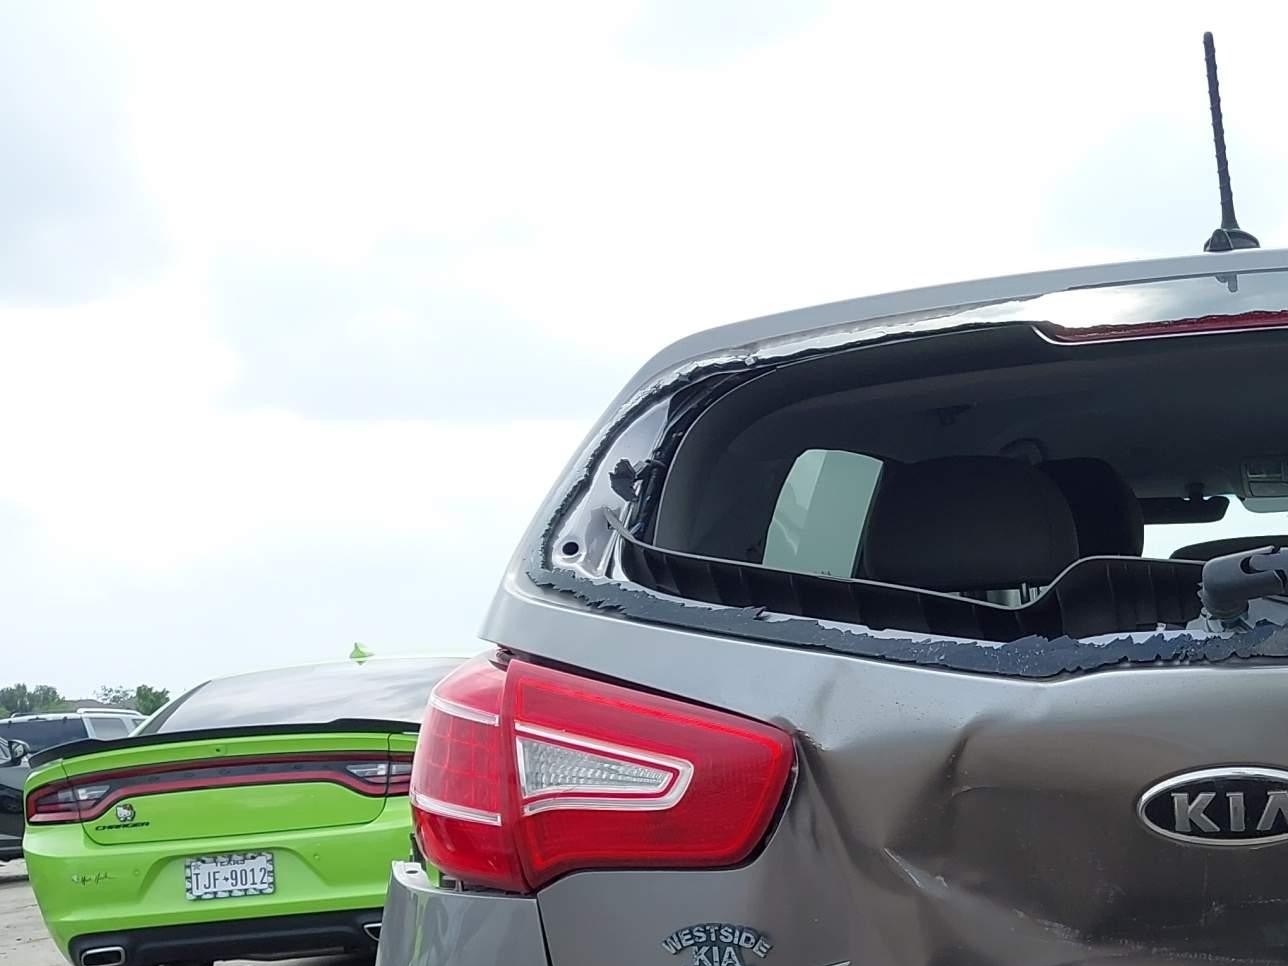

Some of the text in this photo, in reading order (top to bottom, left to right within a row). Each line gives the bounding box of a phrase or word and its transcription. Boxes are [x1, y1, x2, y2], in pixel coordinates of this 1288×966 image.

[193, 867, 267, 890] TJF 9012
[661, 924, 773, 959] WESTSIDE
[692, 945, 741, 966] KIA
